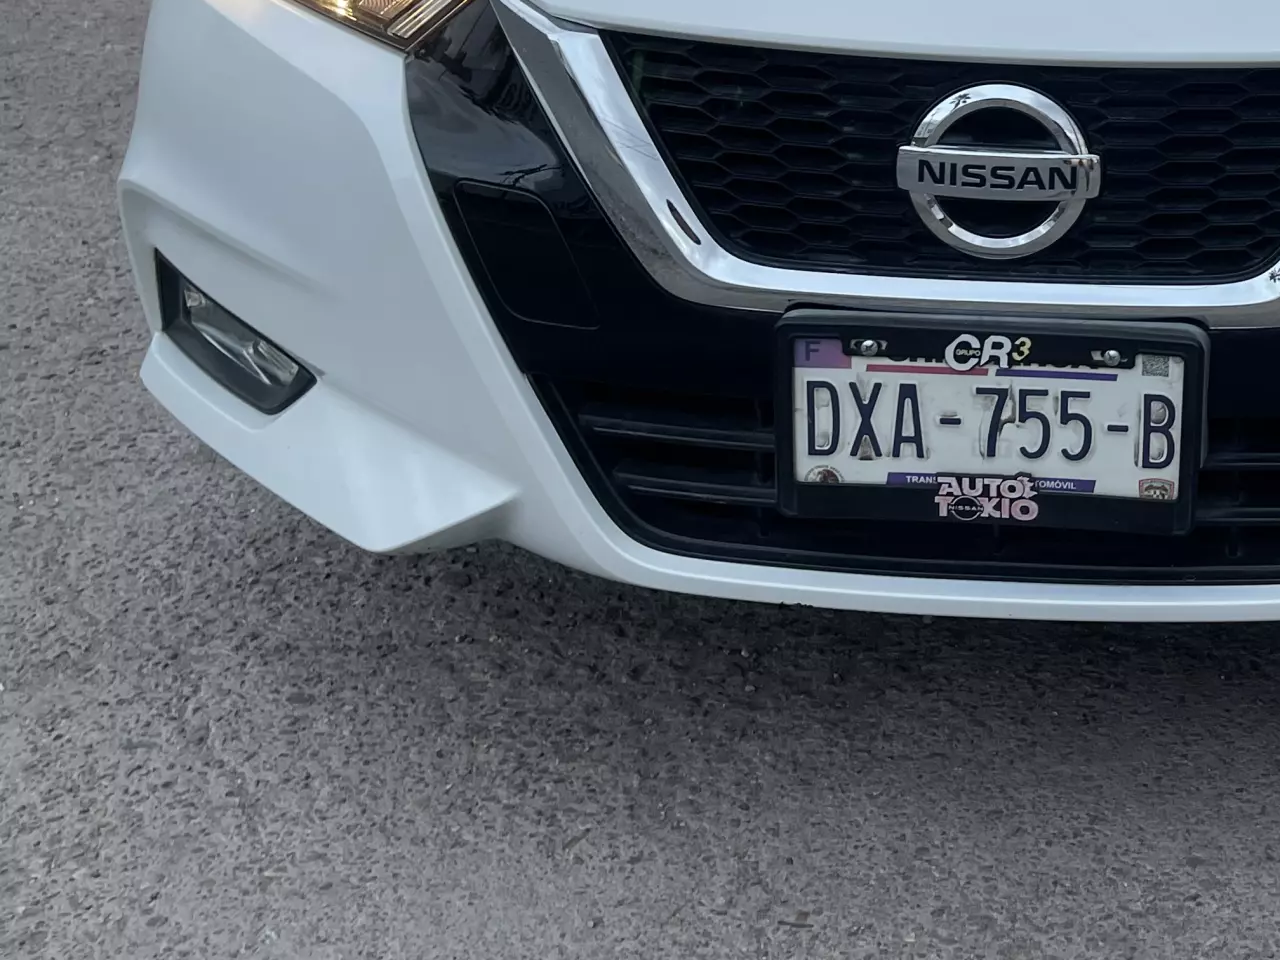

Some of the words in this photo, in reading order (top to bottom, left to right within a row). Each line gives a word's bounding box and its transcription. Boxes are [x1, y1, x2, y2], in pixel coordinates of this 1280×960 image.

[917, 159, 1078, 191] NISSAN
[955, 348, 981, 357] GRUPO
[805, 380, 1176, 470] DXA-755-B
[936, 476, 1025, 499] AUTO
[948, 504, 984, 512] NISSAN
